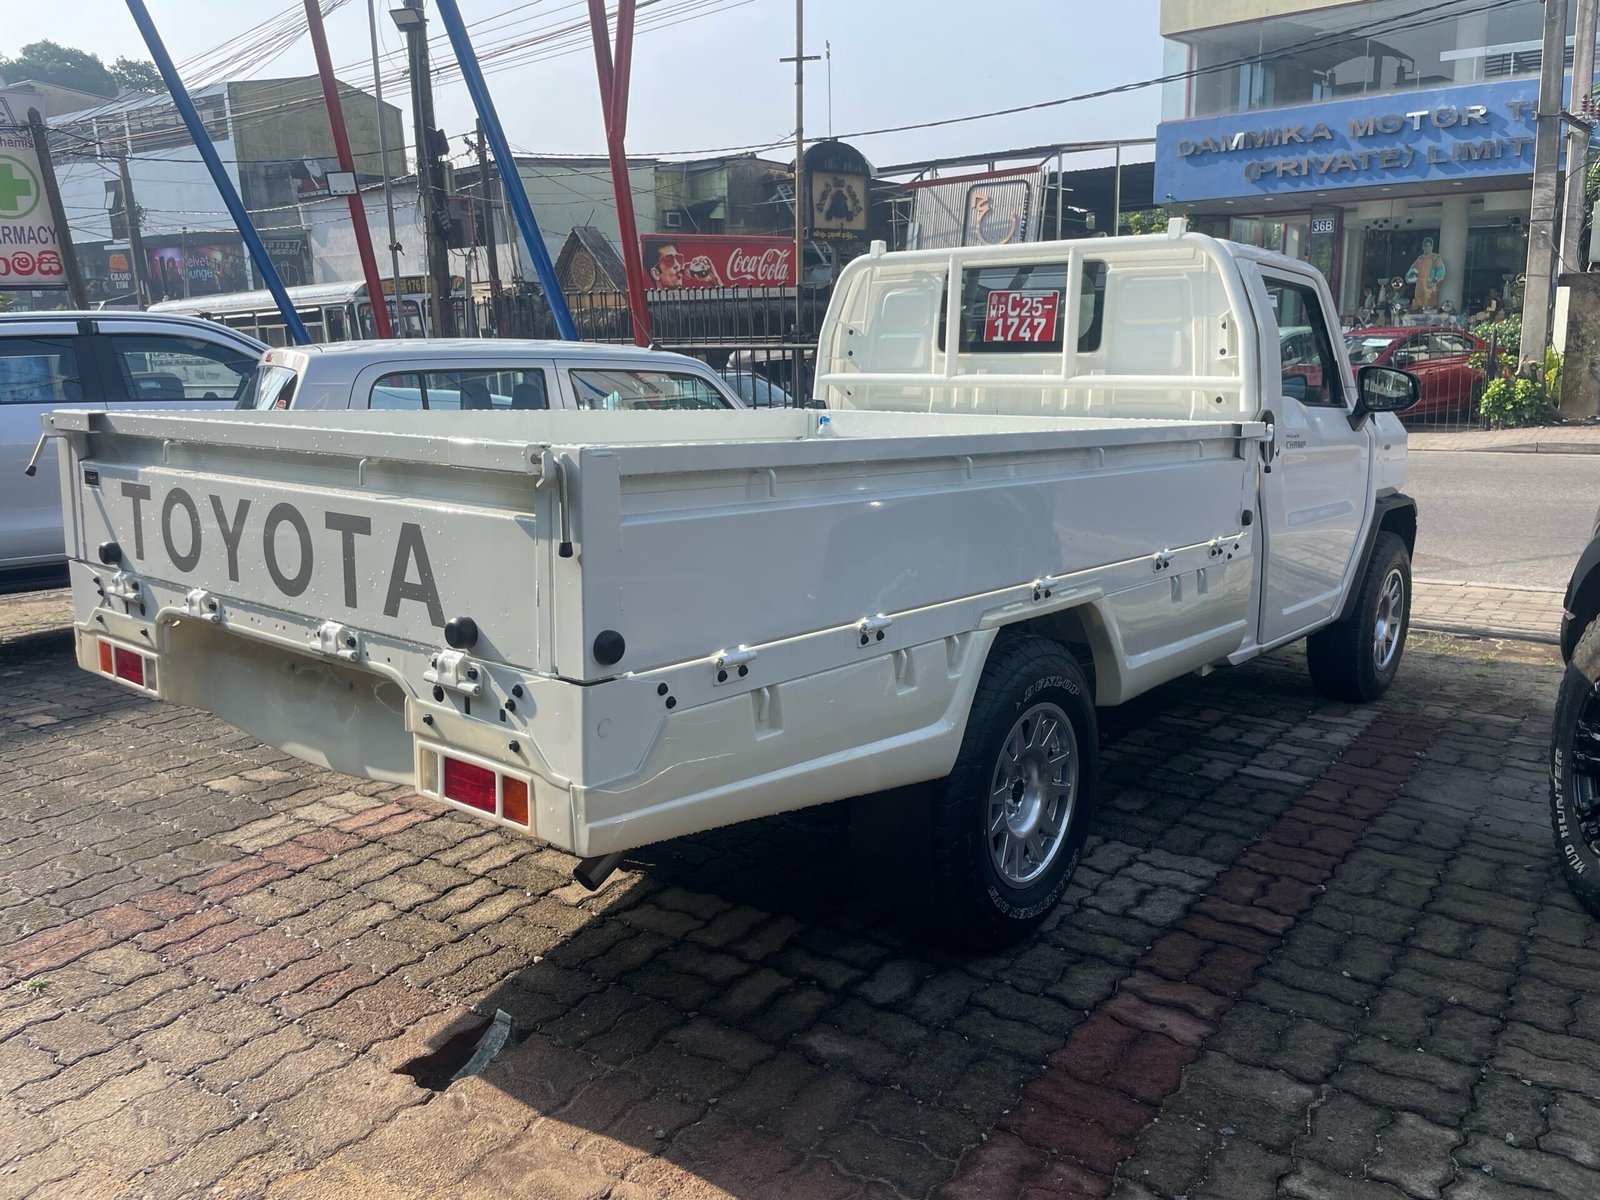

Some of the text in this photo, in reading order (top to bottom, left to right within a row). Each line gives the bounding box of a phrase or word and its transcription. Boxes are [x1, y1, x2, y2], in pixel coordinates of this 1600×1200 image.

[1176, 121, 1333, 157] DAMMIKA
[1347, 105, 1488, 140] MOTOR
[1244, 144, 1414, 183] (PRIVATE)
[1313, 220, 1333, 232] 36B
[726, 247, 791, 281] Coca-Cola
[407, 280, 421, 292] 176
[990, 304, 1006, 317] WP
[992, 318, 1046, 342] 1747
[121, 482, 446, 628] TOYOTA
[1023, 675, 1080, 702] DUNLOP
[1554, 748, 1588, 874] MUD HUNTER
